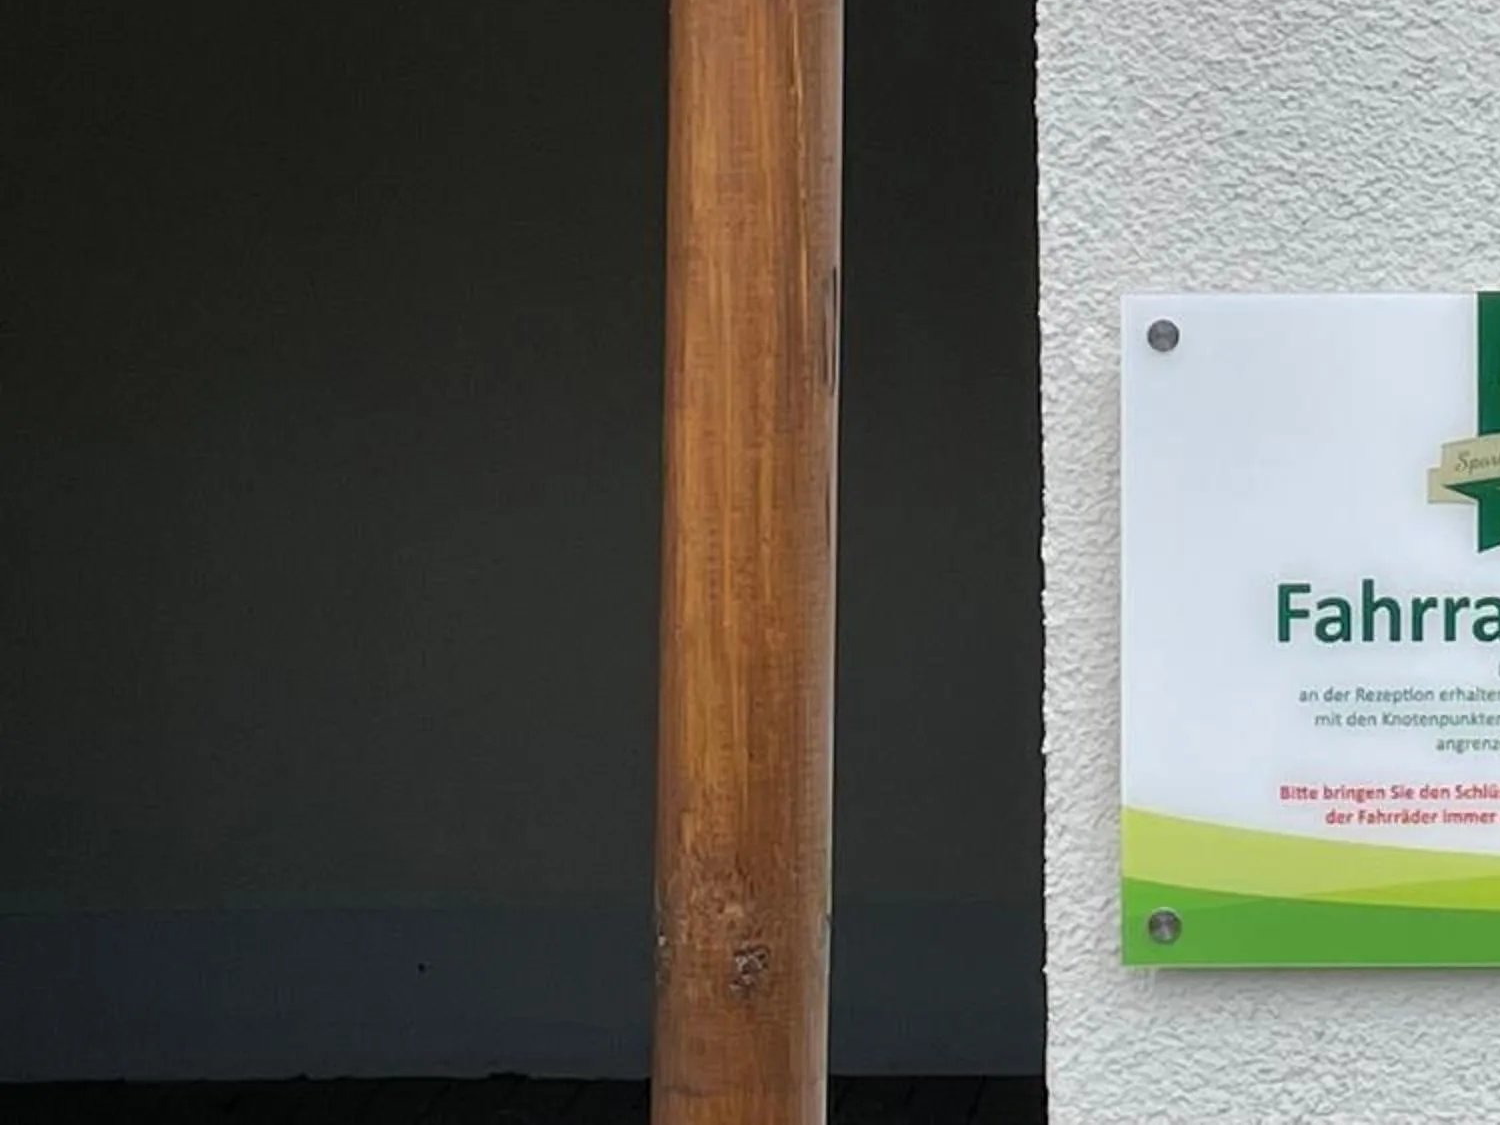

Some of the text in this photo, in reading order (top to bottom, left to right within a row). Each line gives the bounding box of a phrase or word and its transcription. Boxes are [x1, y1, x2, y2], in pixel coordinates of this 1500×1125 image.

[1299, 690, 1319, 702] an
[1323, 687, 1351, 702] der
[1355, 687, 1434, 705] Rezeption
[1314, 712, 1342, 726] mit
[1346, 712, 1377, 726] den
[1280, 785, 1318, 800] Bitte
[1323, 784, 1385, 803] bringen
[1390, 784, 1414, 800] Sie
[1419, 784, 1449, 800] den
[1325, 808, 1351, 824] der
[1357, 808, 1438, 824] Fahrräder
[1443, 809, 1494, 824] immer
